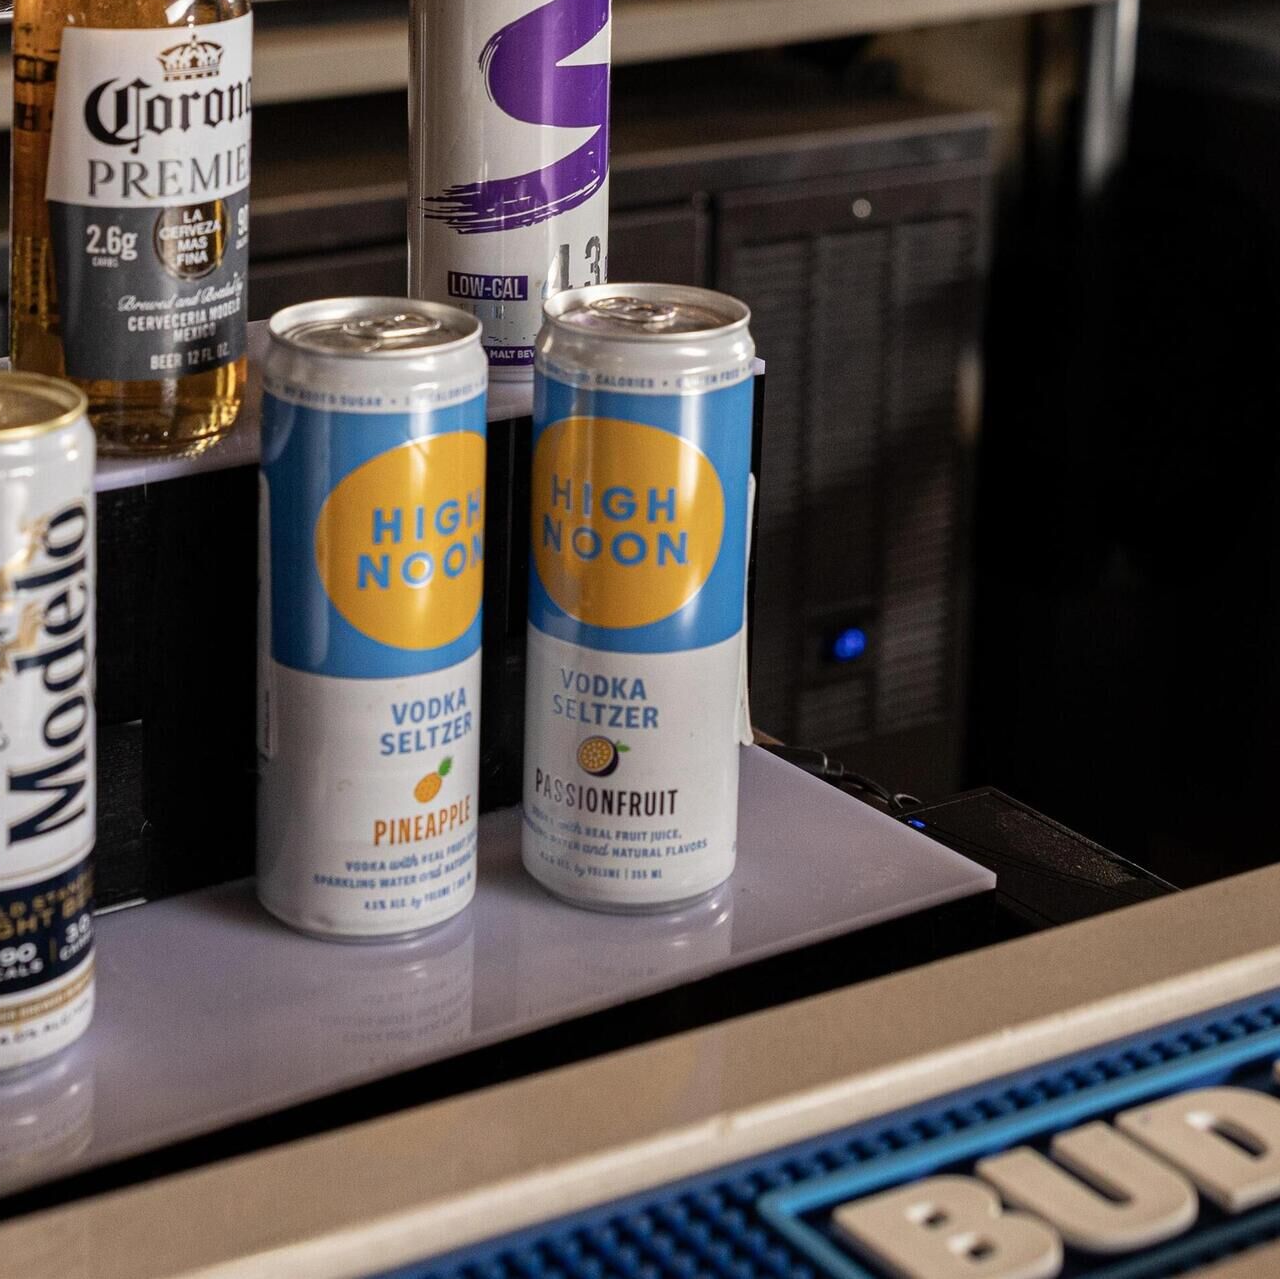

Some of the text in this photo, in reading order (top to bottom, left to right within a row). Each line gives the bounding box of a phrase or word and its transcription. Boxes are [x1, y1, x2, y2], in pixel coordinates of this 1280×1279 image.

[88, 142, 249, 200] PREMIE
[159, 221, 222, 240] CERVEZA
[183, 209, 203, 224] LA
[85, 224, 138, 261] 2.6g
[176, 251, 209, 267] FINA
[177, 236, 209, 252] MAS
[451, 273, 524, 299] LOW-CAL
[127, 309, 208, 332] CERVECERIA
[150, 353, 183, 370] BEER
[490, 349, 518, 360] MALT
[594, 374, 654, 389] CALORIES
[372, 486, 482, 544] HIGH
[550, 473, 678, 525] HIGH
[542, 511, 689, 568] NOON
[356, 528, 484, 590] NOON
[8, 501, 88, 845] Modelo
[561, 667, 648, 701] VODKA
[390, 686, 468, 726] VODKA
[552, 694, 660, 730] SELTZER
[380, 711, 472, 757] SELTZER
[535, 767, 679, 818] PASSIONFRUIT
[373, 794, 472, 848] PINEAPPLE
[615, 830, 648, 842] FRUIT
[582, 842, 609, 857] and
[612, 845, 662, 859] NATURAL
[665, 838, 709, 857] FLAVORS
[379, 874, 417, 888] WATER
